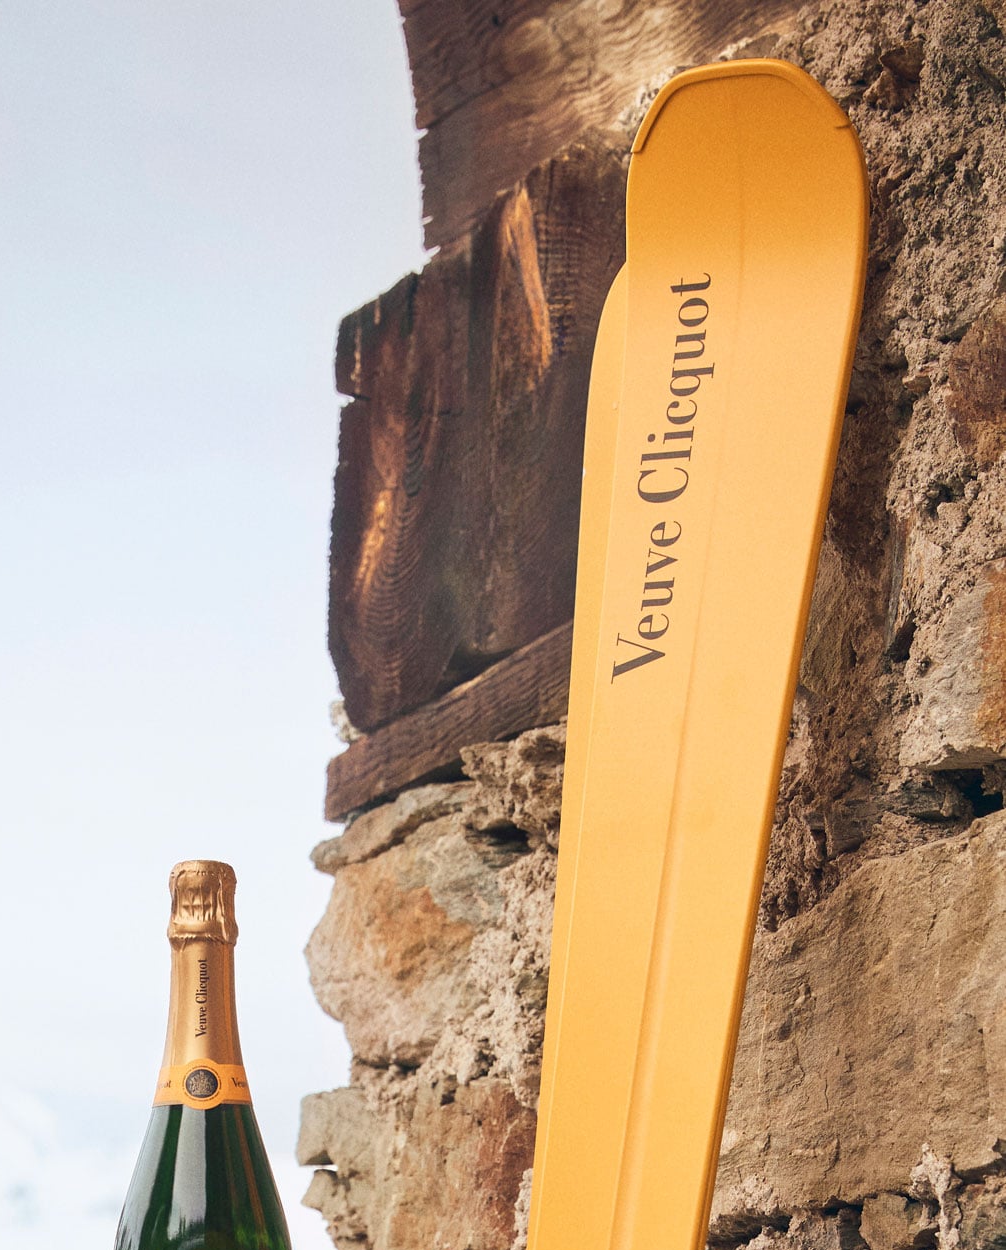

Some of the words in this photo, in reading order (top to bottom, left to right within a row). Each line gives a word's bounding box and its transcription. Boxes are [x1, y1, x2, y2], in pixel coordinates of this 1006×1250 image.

[637, 272, 715, 504] Clicquot
[611, 519, 682, 685] Veuve
[195, 958, 210, 1004] Clicquot
[195, 1005, 208, 1038] Veuve
